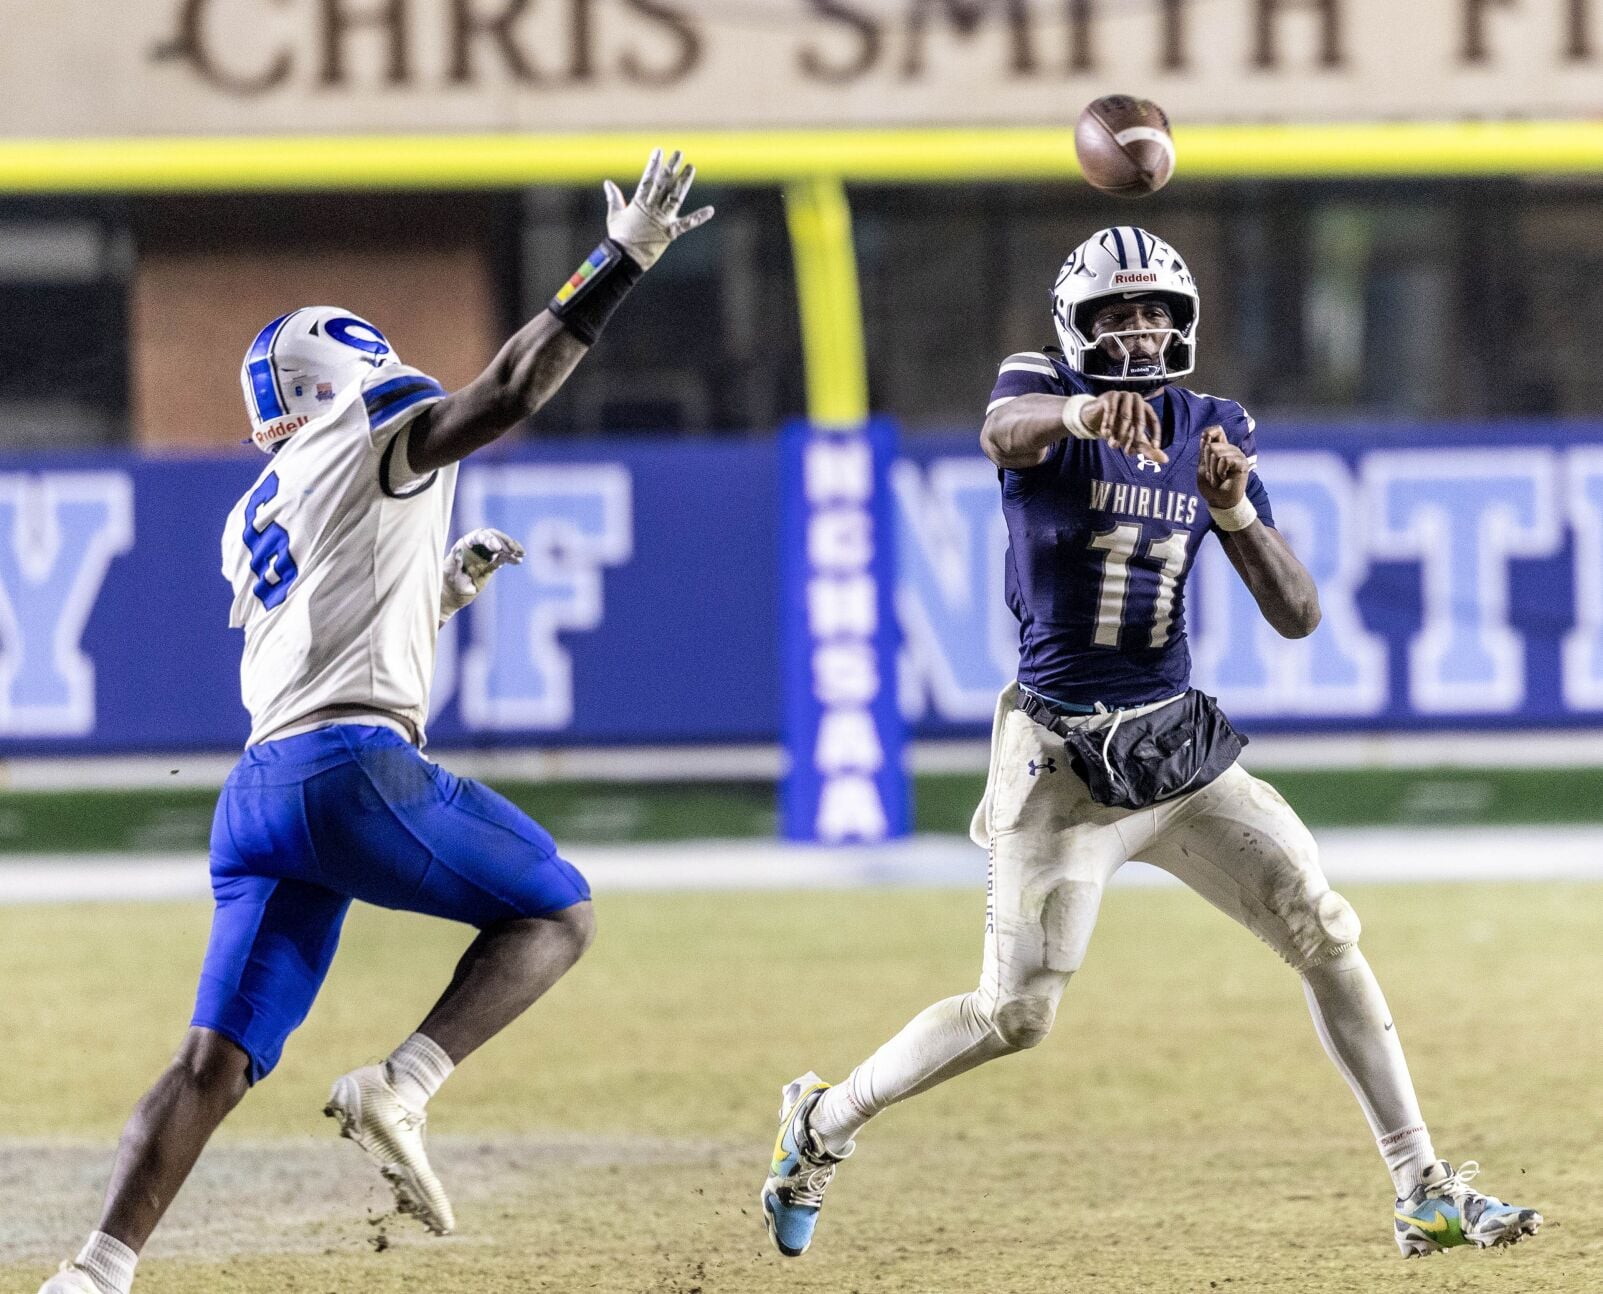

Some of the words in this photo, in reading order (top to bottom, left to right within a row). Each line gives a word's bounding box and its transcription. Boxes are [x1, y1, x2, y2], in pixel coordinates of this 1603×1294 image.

[152, 0, 703, 96] CHRIS
[1115, 273, 1157, 284] Riddell
[242, 471, 299, 612] 6
[1088, 478, 1199, 525] WHIRLIES
[892, 447, 1603, 720] NRT
[1086, 521, 1192, 651] 11
